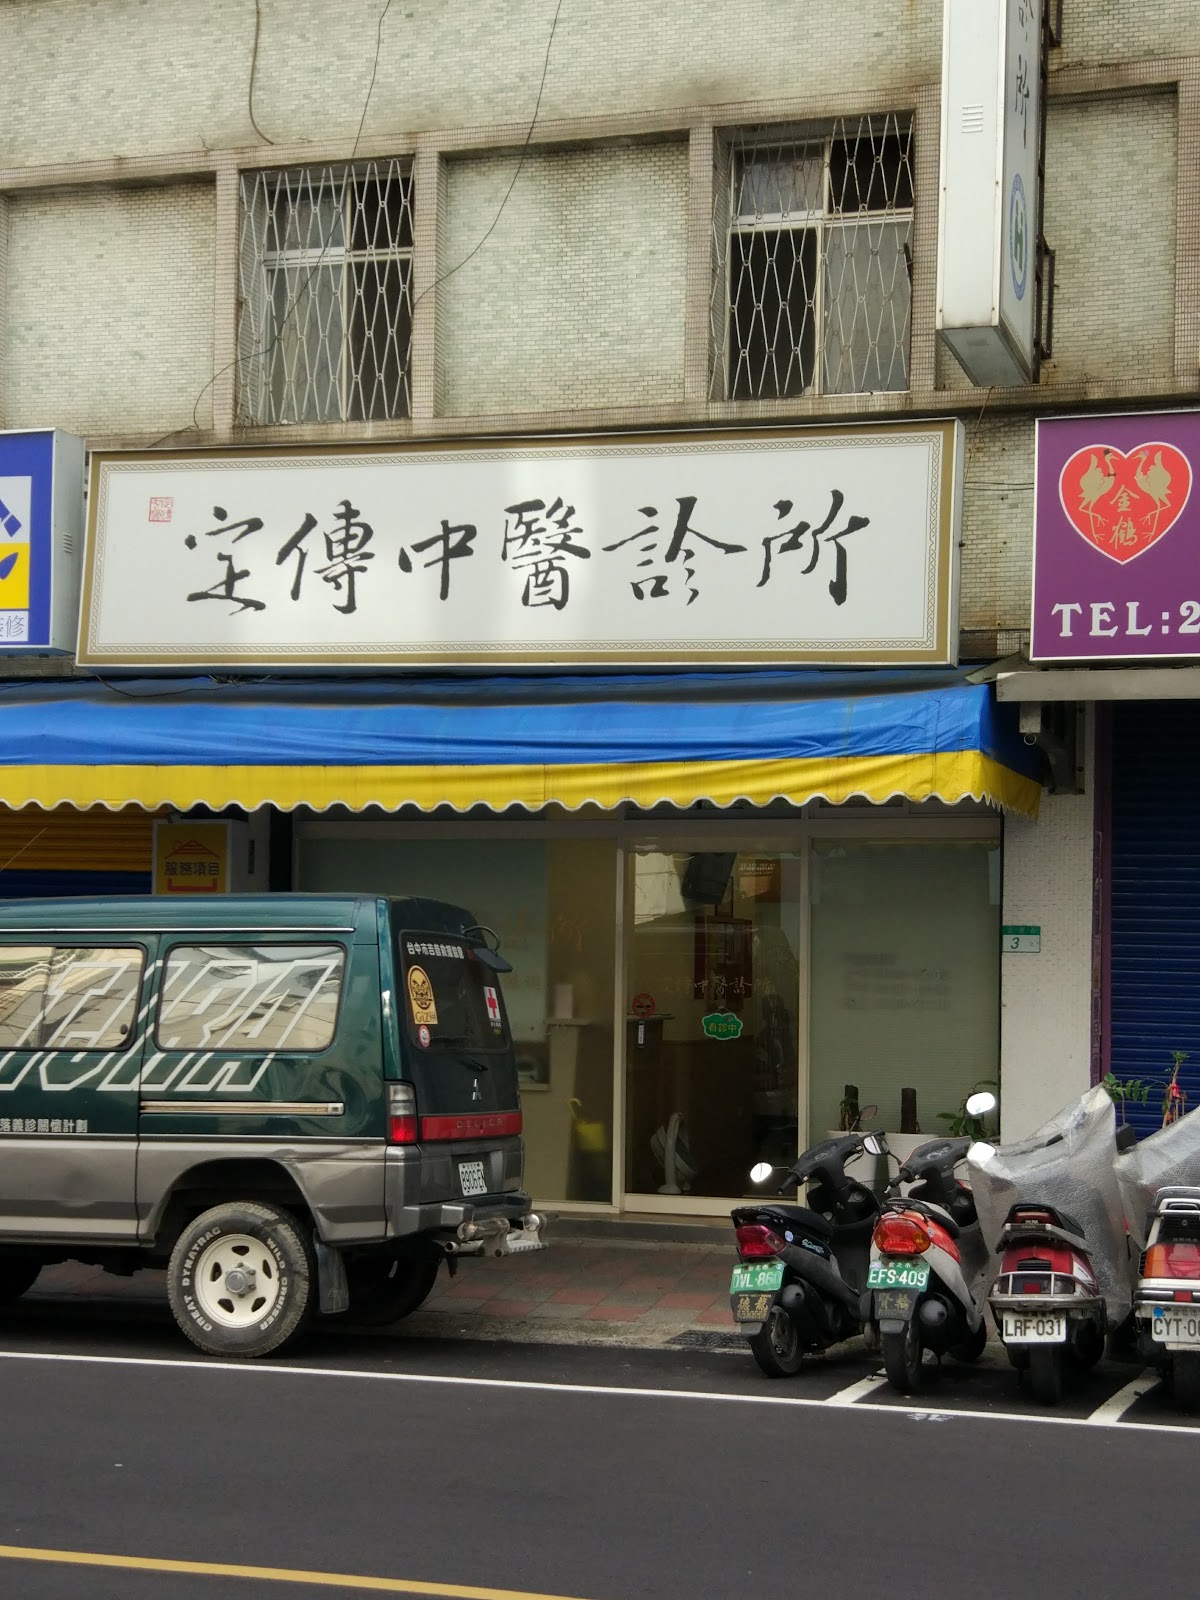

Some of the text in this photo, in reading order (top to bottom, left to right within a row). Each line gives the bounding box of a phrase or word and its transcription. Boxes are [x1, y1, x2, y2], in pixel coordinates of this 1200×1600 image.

[1108, 484, 1141, 550] 金鶴
[184, 489, 871, 616] 定傳中醫診所
[0, 615, 25, 638] 修
[1010, 936, 1020, 950] 3
[259, 1238, 288, 1331] WILD CRUISER
[1153, 1317, 1200, 1337] CYT·0
